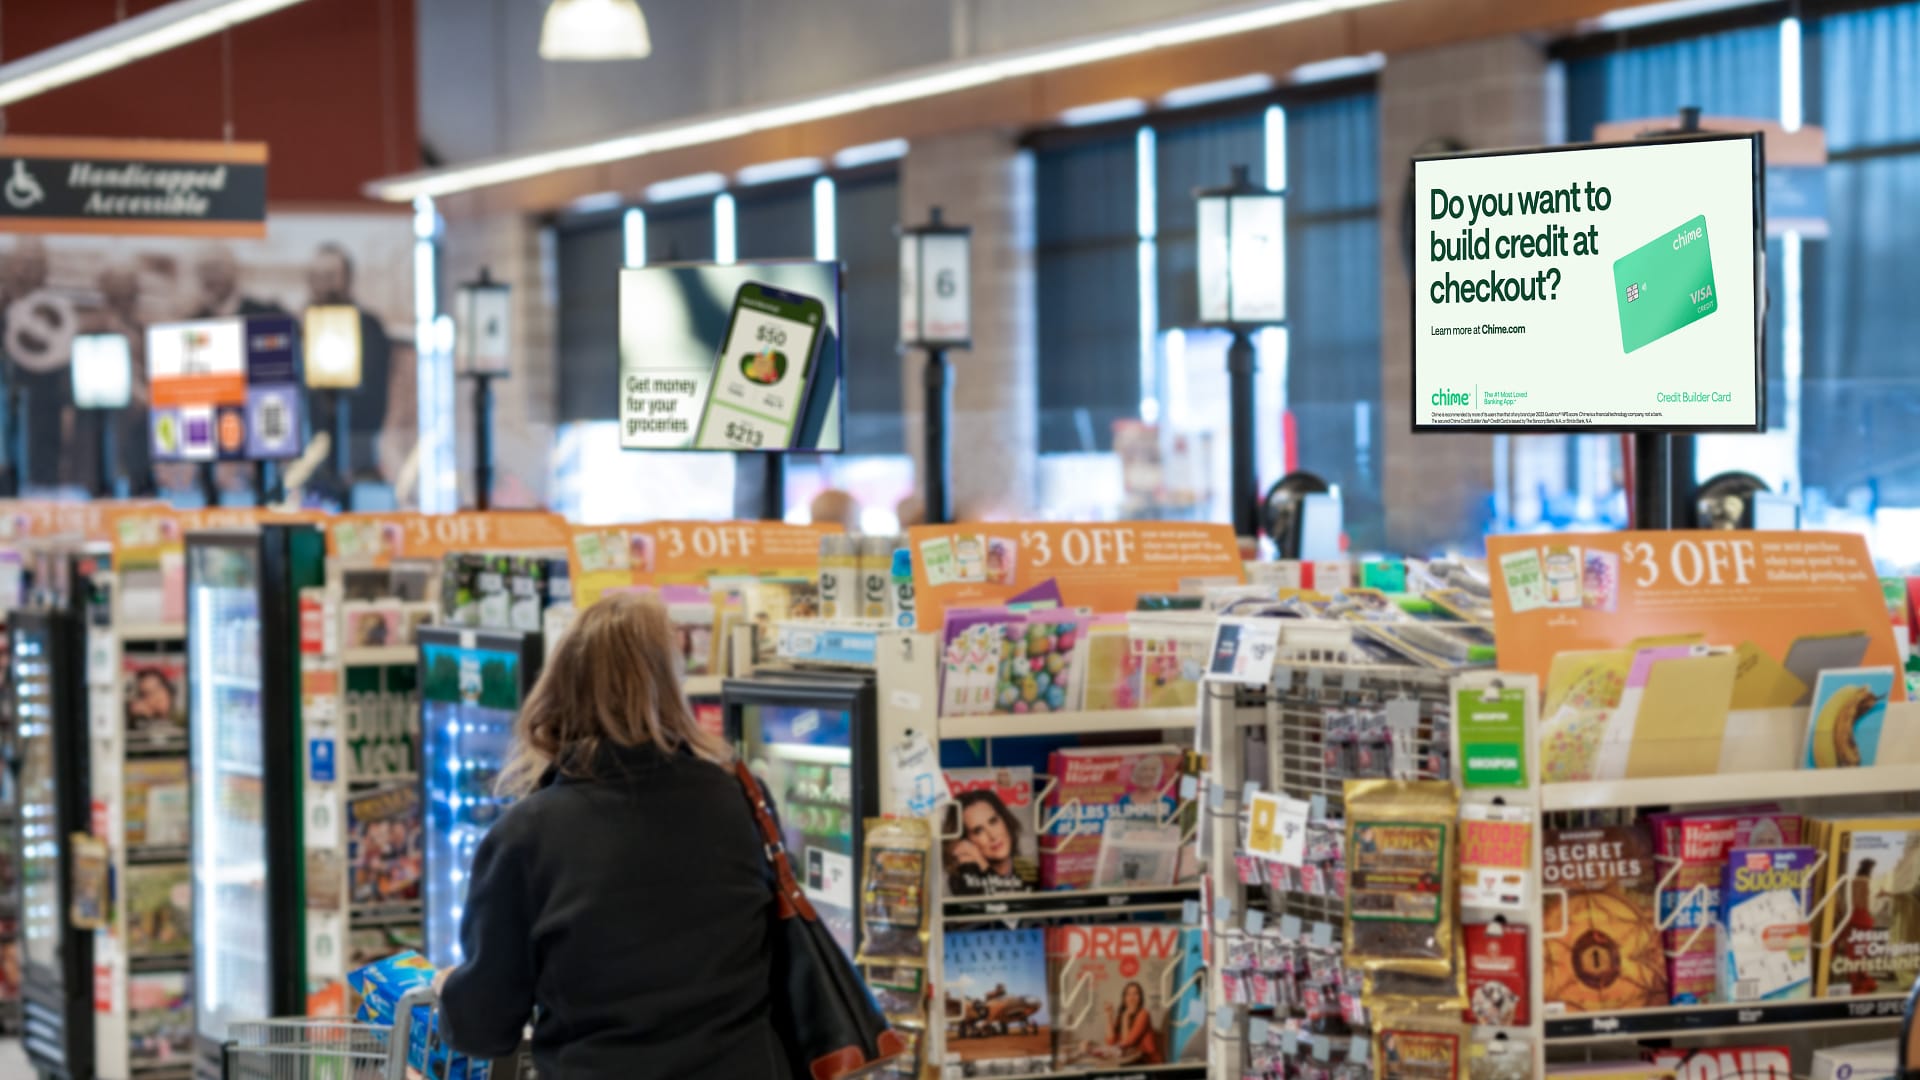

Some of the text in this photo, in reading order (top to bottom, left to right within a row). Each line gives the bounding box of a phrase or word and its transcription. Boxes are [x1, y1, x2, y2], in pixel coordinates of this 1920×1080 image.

[67, 162, 227, 194] Handicapped
[84, 191, 210, 216] Accessible
[1430, 181, 1612, 225] Do you want to
[1430, 224, 1599, 262] build credit at
[1672, 227, 1703, 250] chime
[936, 269, 955, 299] 6
[1430, 267, 1562, 304] checkout?
[1689, 284, 1713, 305] VISA
[756, 325, 788, 347] $50
[1431, 324, 1526, 336] Learn more at Chime.com
[626, 376, 698, 398] Get money
[1657, 392, 1732, 403] Credit Builder Card
[626, 396, 678, 416] for your
[626, 417, 689, 437] groceries
[725, 422, 764, 448] $213
[435, 516, 490, 545] OFF
[691, 526, 755, 558] OFF
[1021, 528, 1136, 567] $3 OFF
[1622, 539, 1756, 588] $3 OFF
[1543, 841, 1623, 864] SECRET
[1543, 858, 1642, 881] OCIETIES
[951, 930, 1040, 949] ILITARY
[1064, 924, 1179, 961] DREW
[1847, 928, 1890, 943] Jesus
[1831, 954, 1920, 975] Christianit
